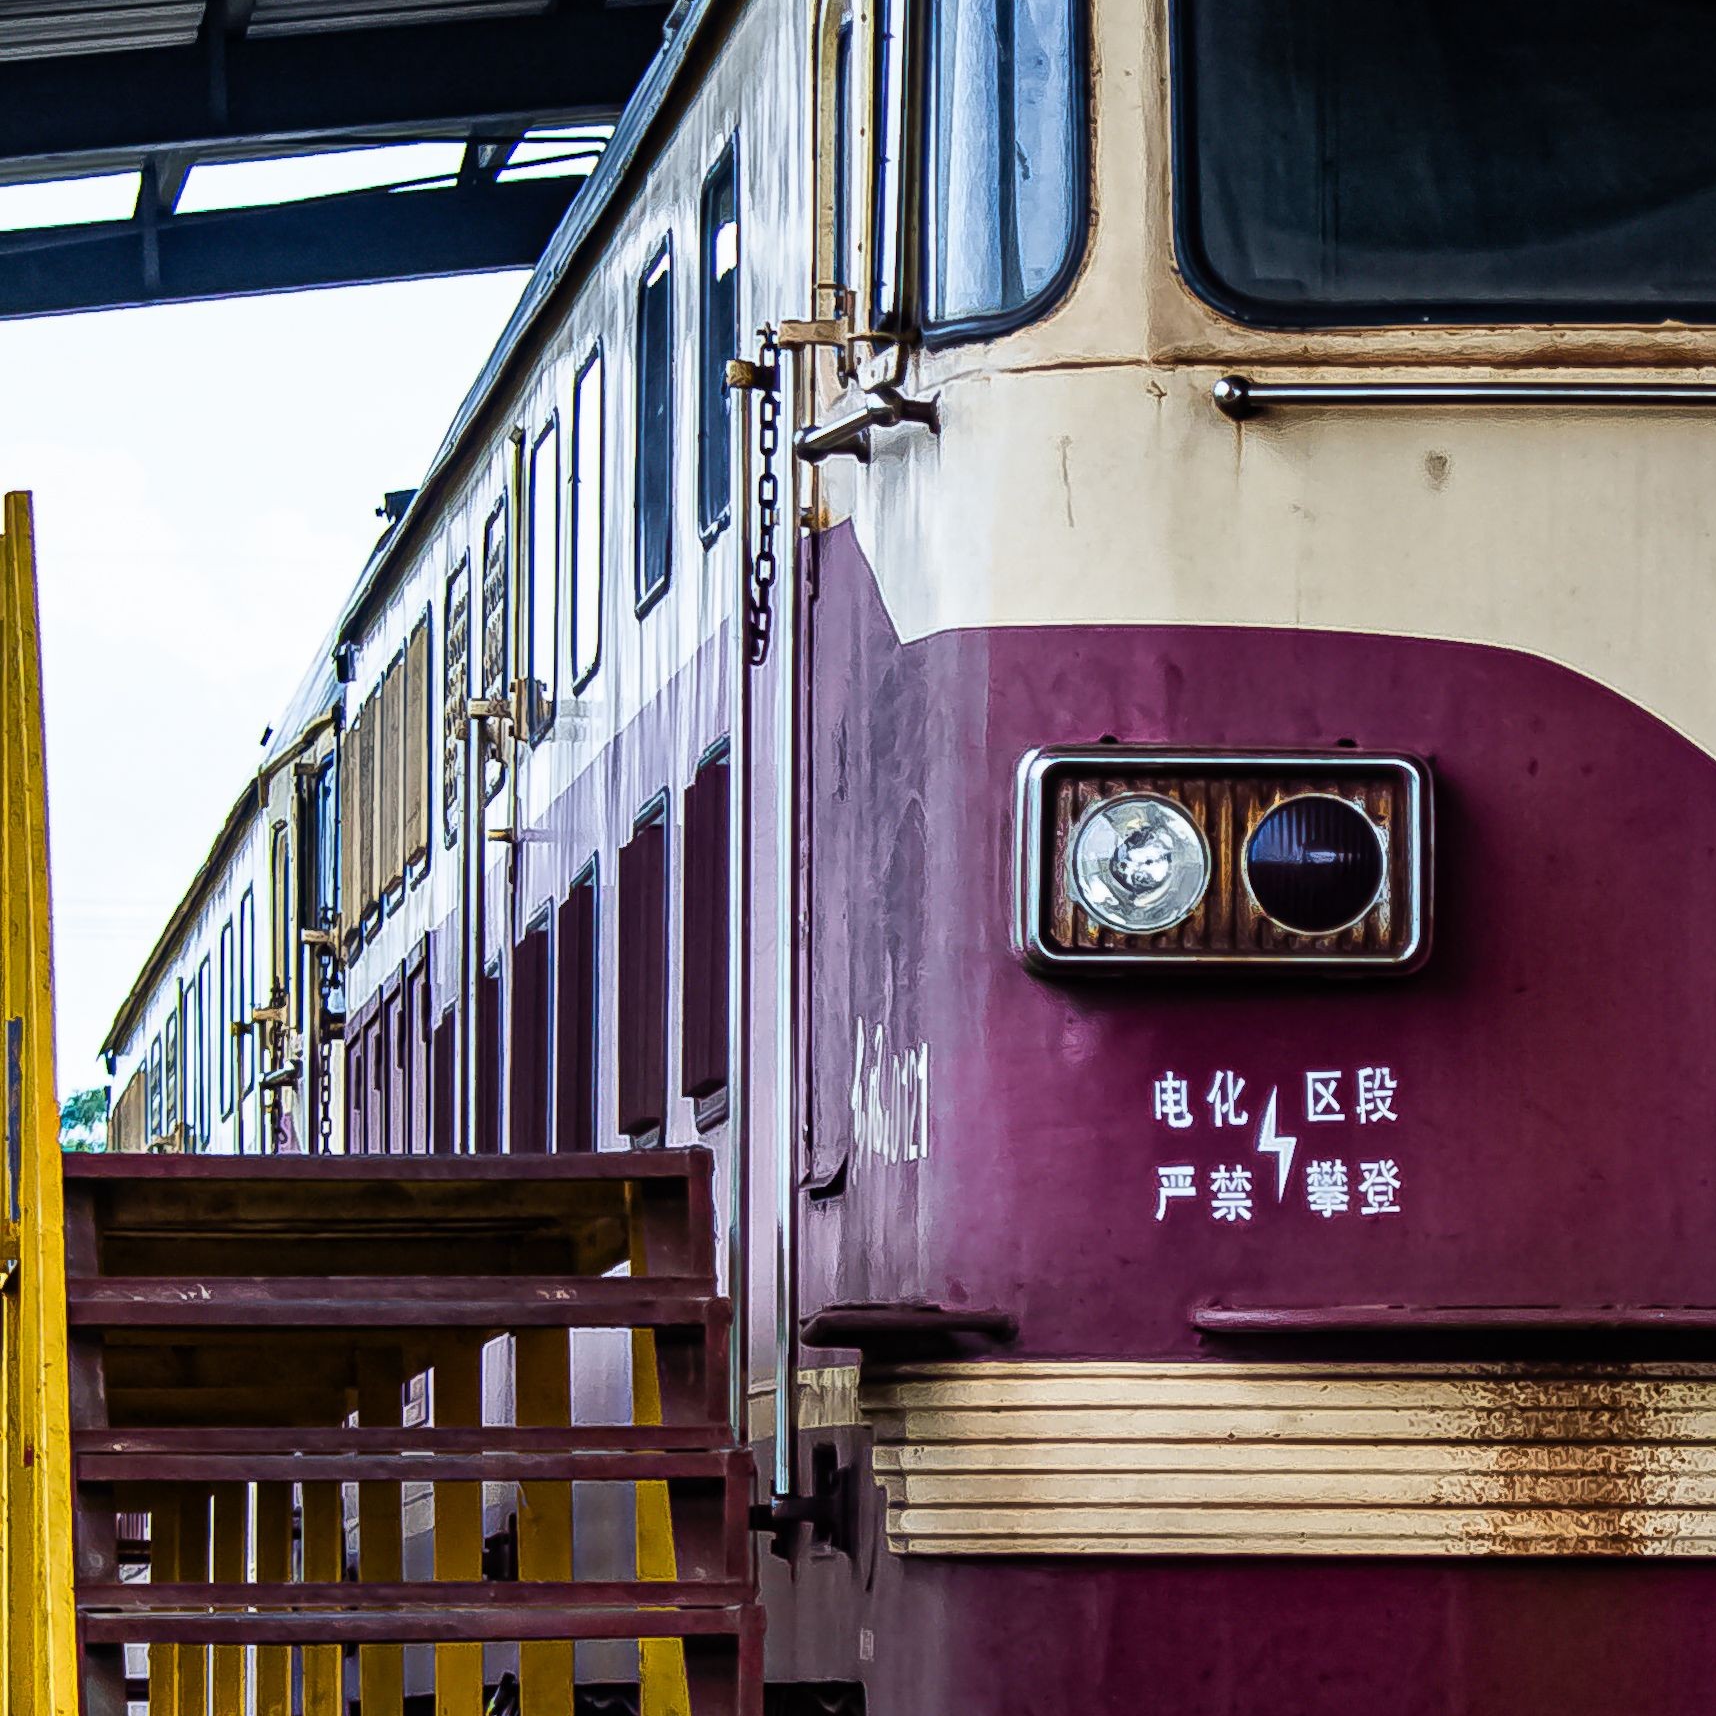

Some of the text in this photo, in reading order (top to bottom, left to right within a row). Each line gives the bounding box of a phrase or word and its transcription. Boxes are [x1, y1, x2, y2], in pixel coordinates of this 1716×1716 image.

[1154, 1066, 1399, 1128] 电化 区段
[1154, 1158, 1402, 1222] 严禁 攀登
